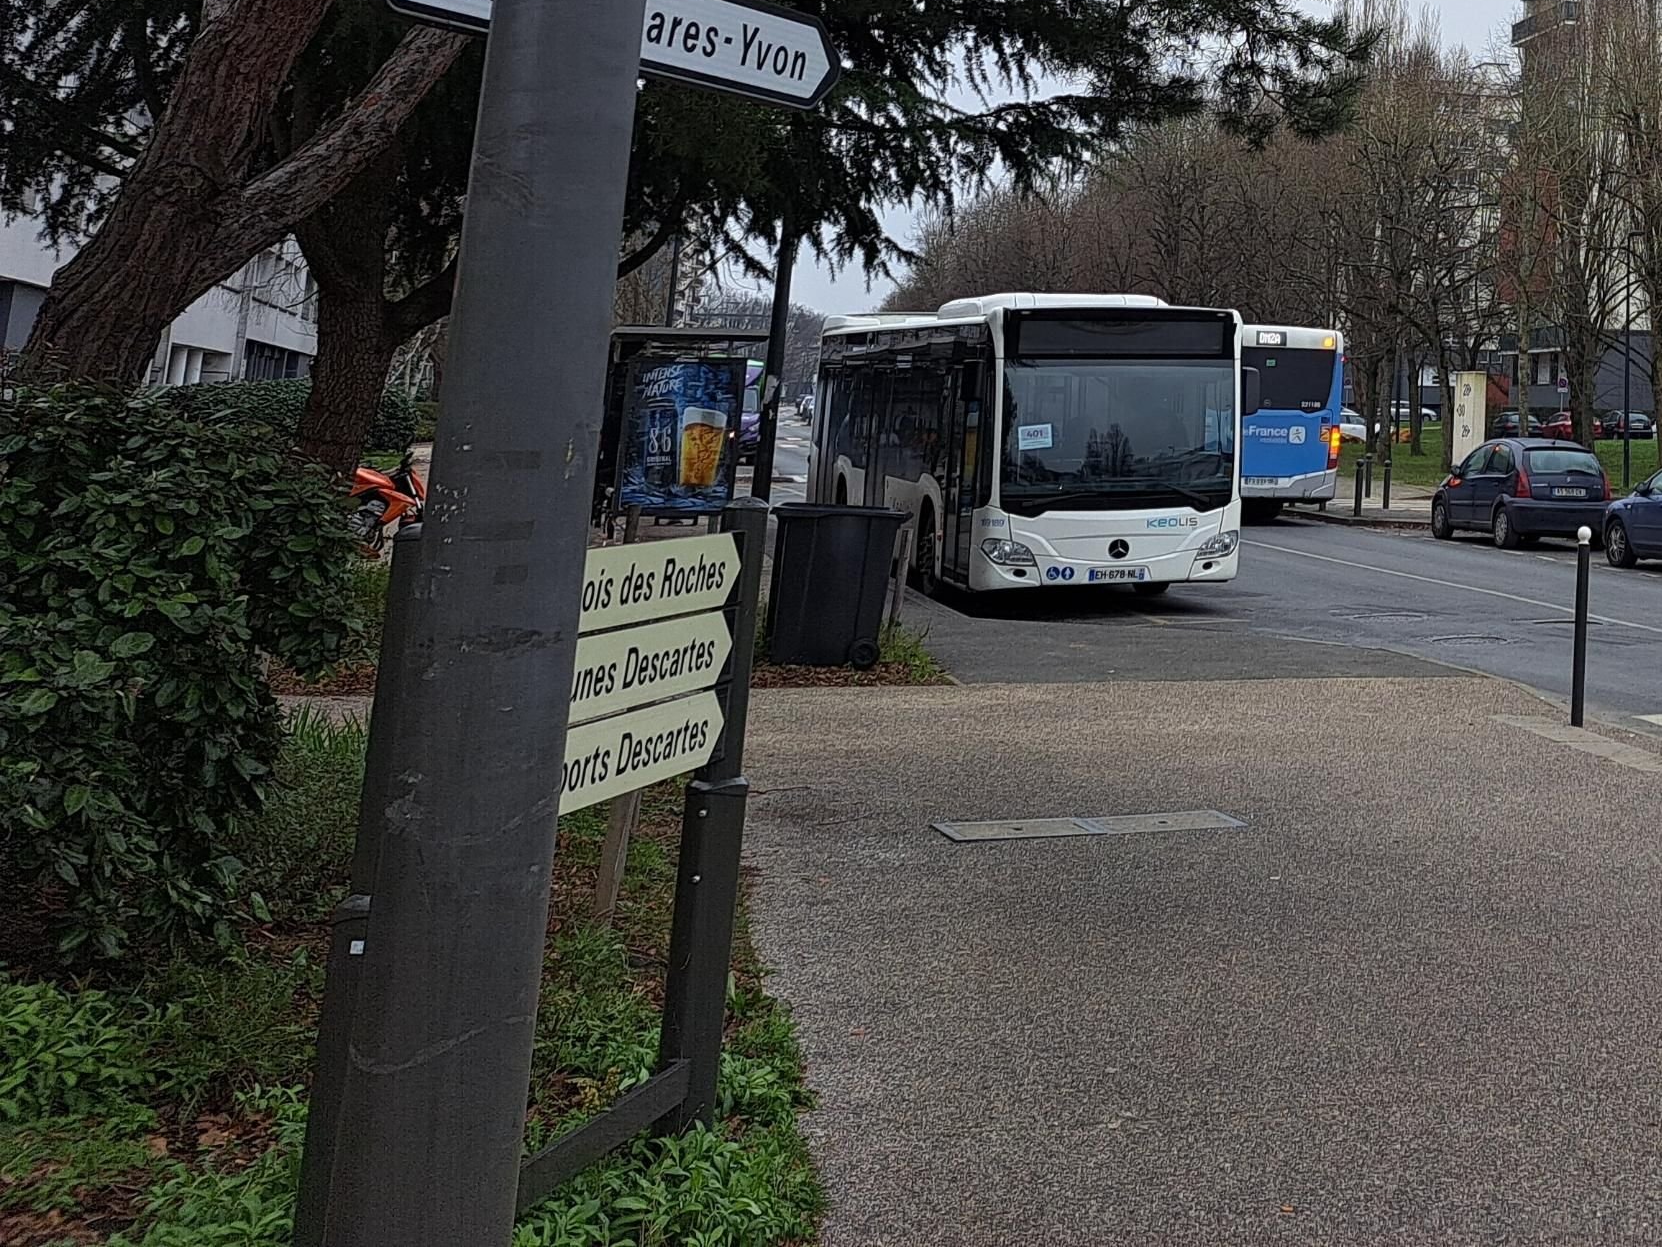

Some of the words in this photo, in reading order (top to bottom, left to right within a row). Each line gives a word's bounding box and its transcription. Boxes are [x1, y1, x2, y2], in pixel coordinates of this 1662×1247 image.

[620, 563, 655, 607] des
[660, 553, 726, 599] Roches
[622, 637, 715, 690] Descartes
[615, 718, 709, 777] Descartes
